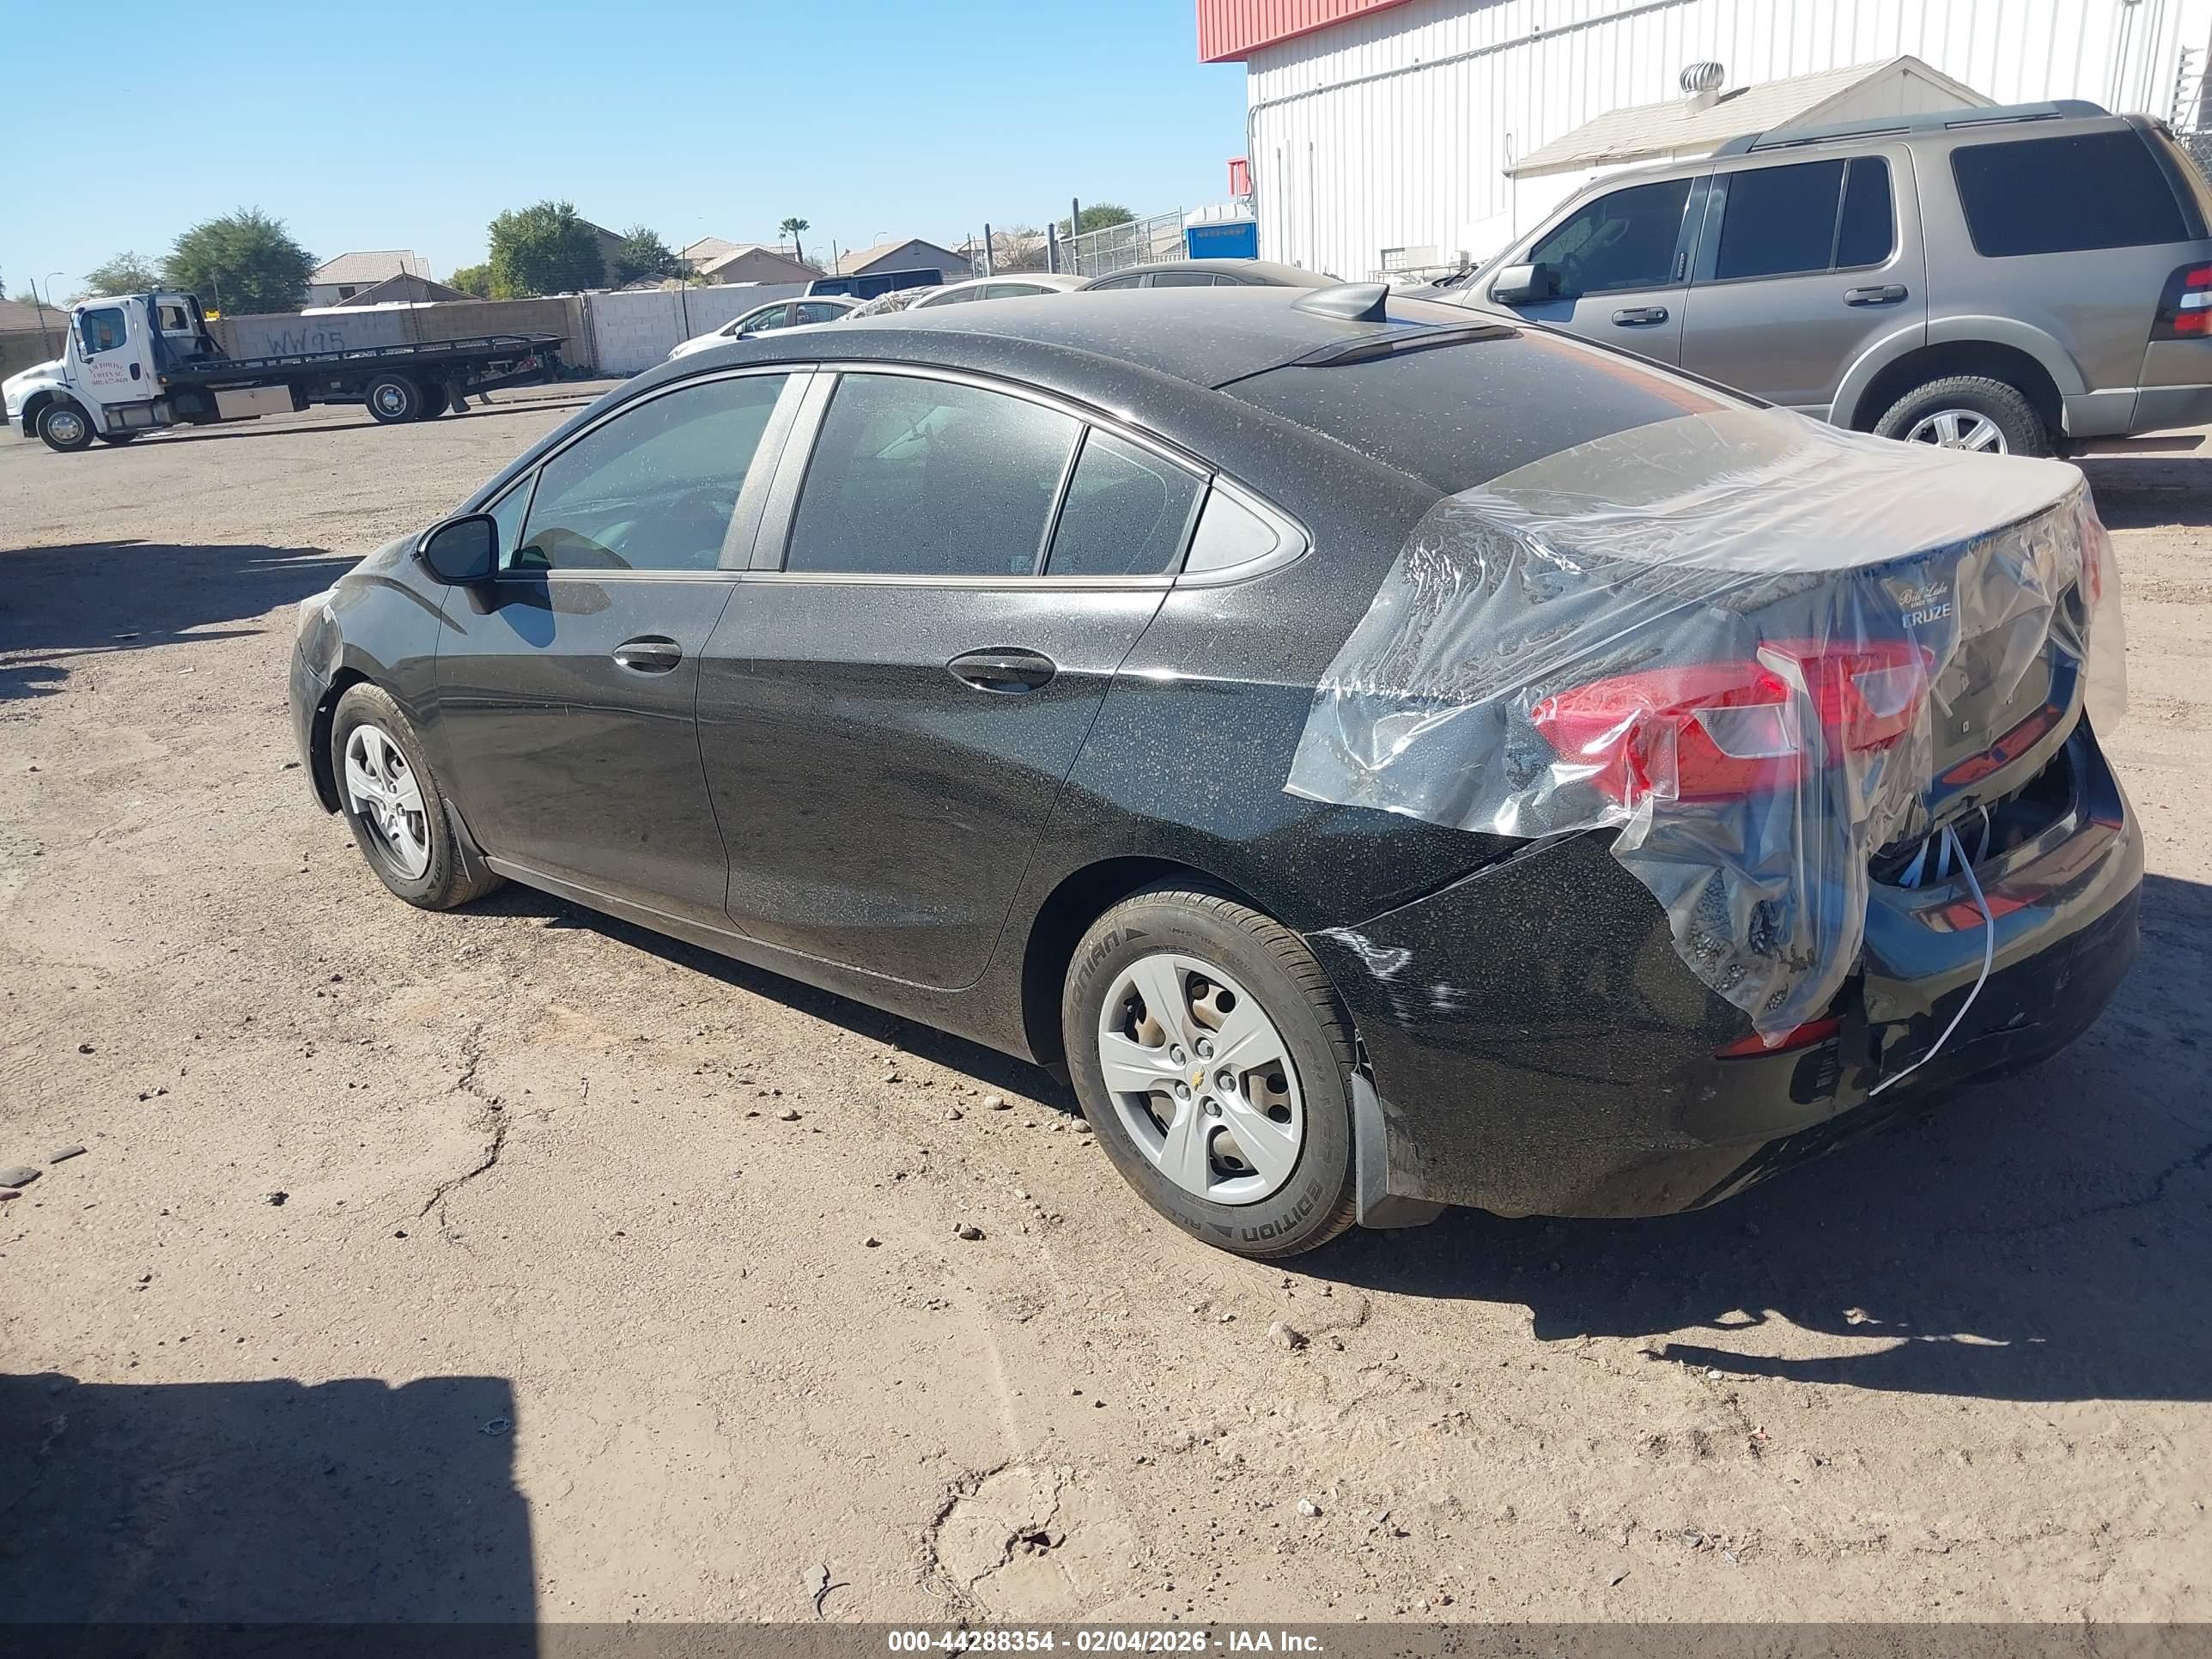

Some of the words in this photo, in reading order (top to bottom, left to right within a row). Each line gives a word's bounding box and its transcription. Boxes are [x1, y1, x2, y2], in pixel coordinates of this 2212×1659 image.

[1898, 586, 1923, 605] Bill
[1923, 580, 1948, 599] Luke
[1902, 603, 1951, 629] CRUZE
[1242, 1178, 1325, 1243] EDITION
